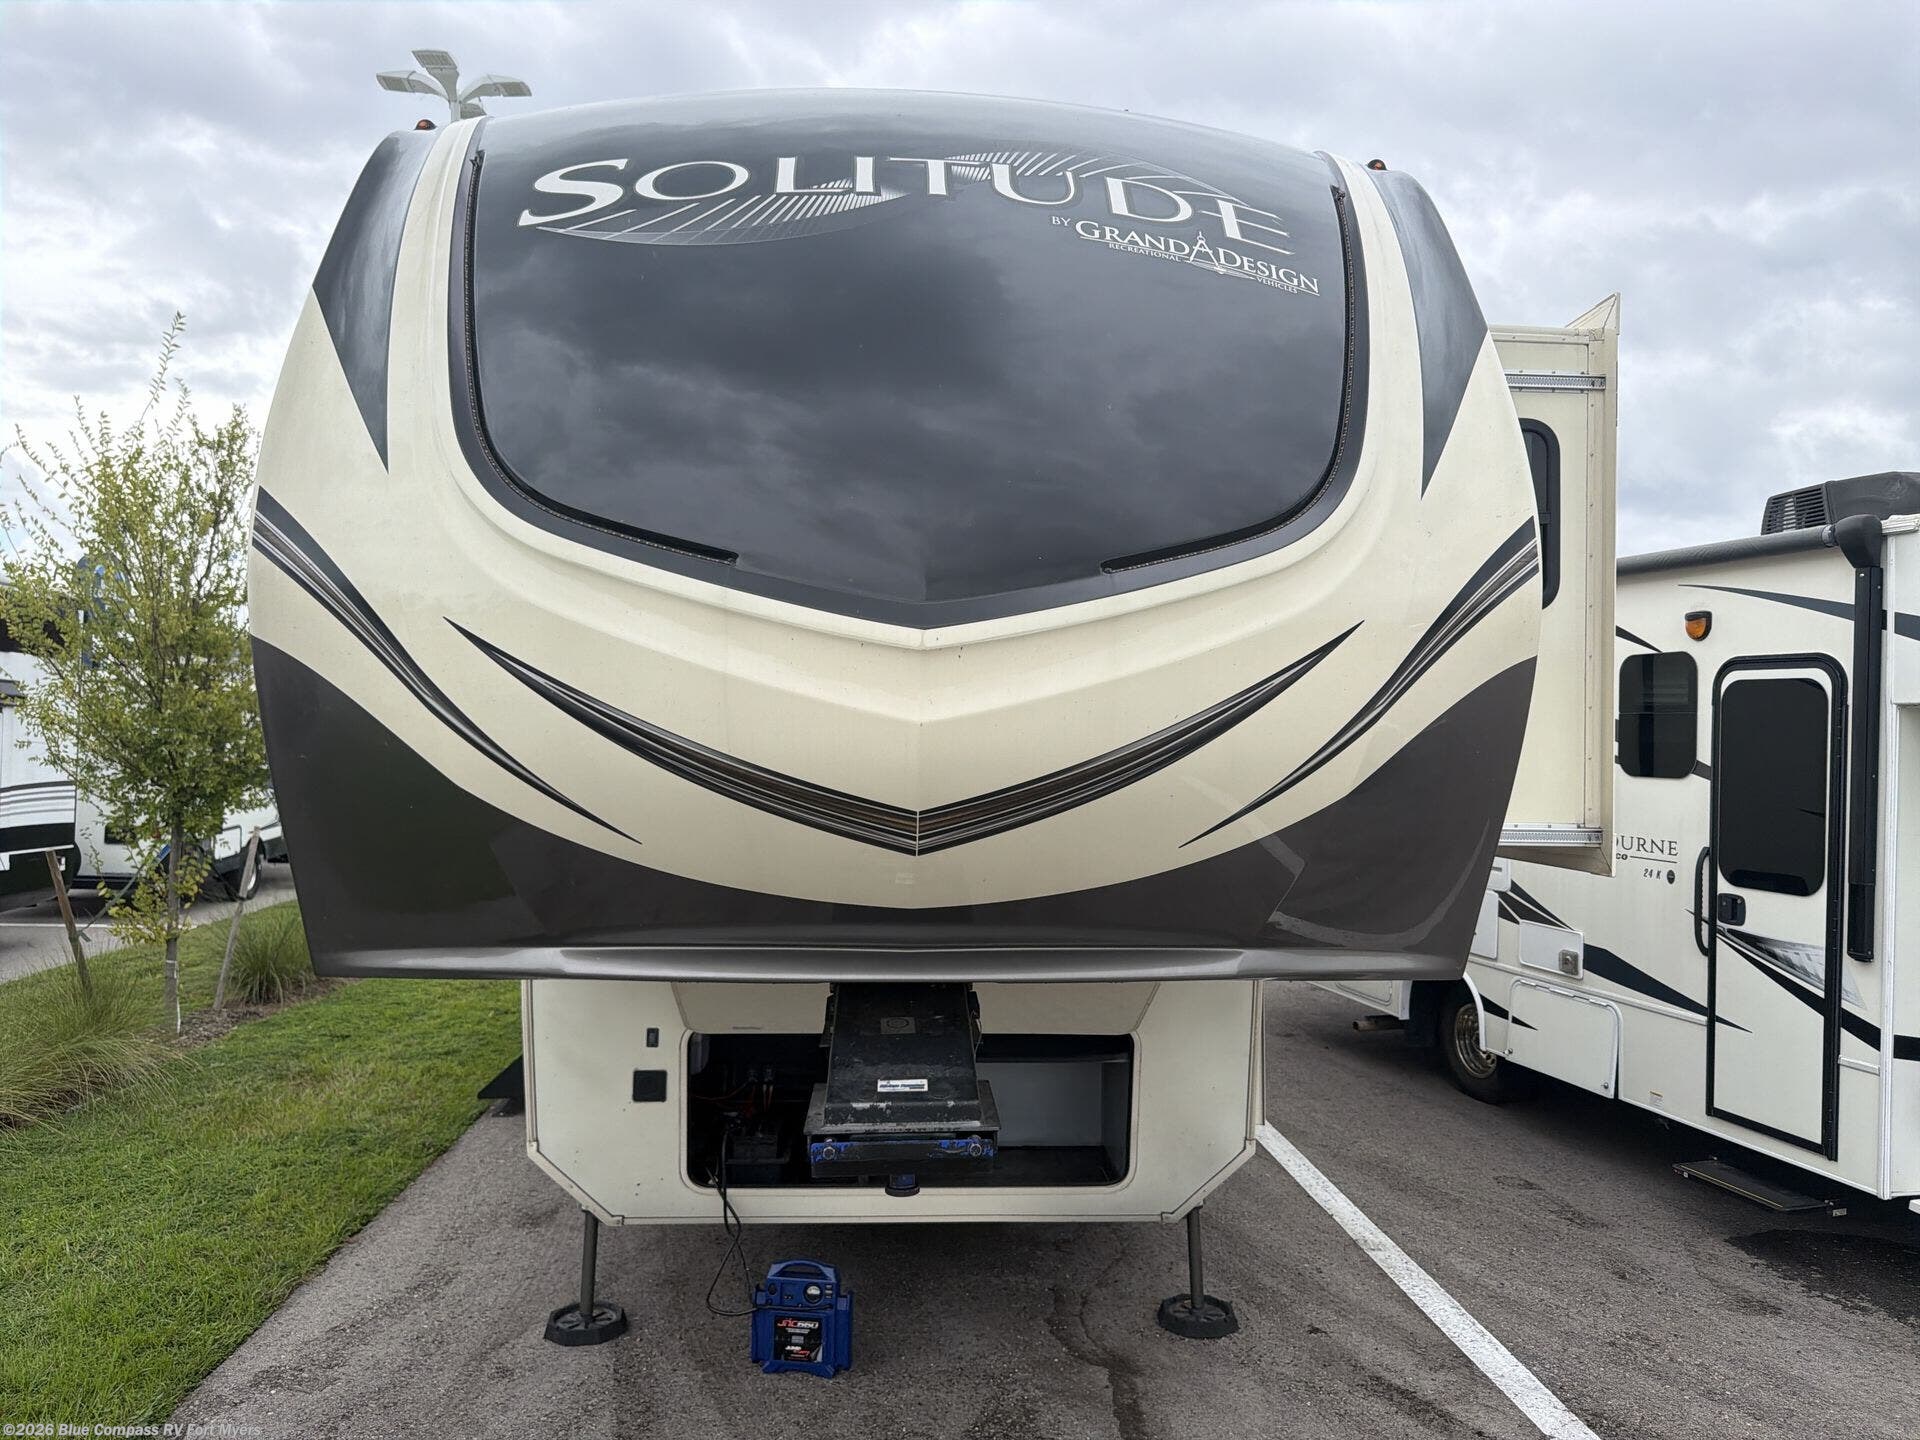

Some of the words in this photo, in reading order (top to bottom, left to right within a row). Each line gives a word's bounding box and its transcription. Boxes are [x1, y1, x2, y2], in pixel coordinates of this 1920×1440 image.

[517, 156, 1296, 255] SOLITUDE
[1051, 216, 1071, 226] BY
[1108, 243, 1182, 262] RECREATIONAL
[1256, 276, 1298, 294] VEHICLES
